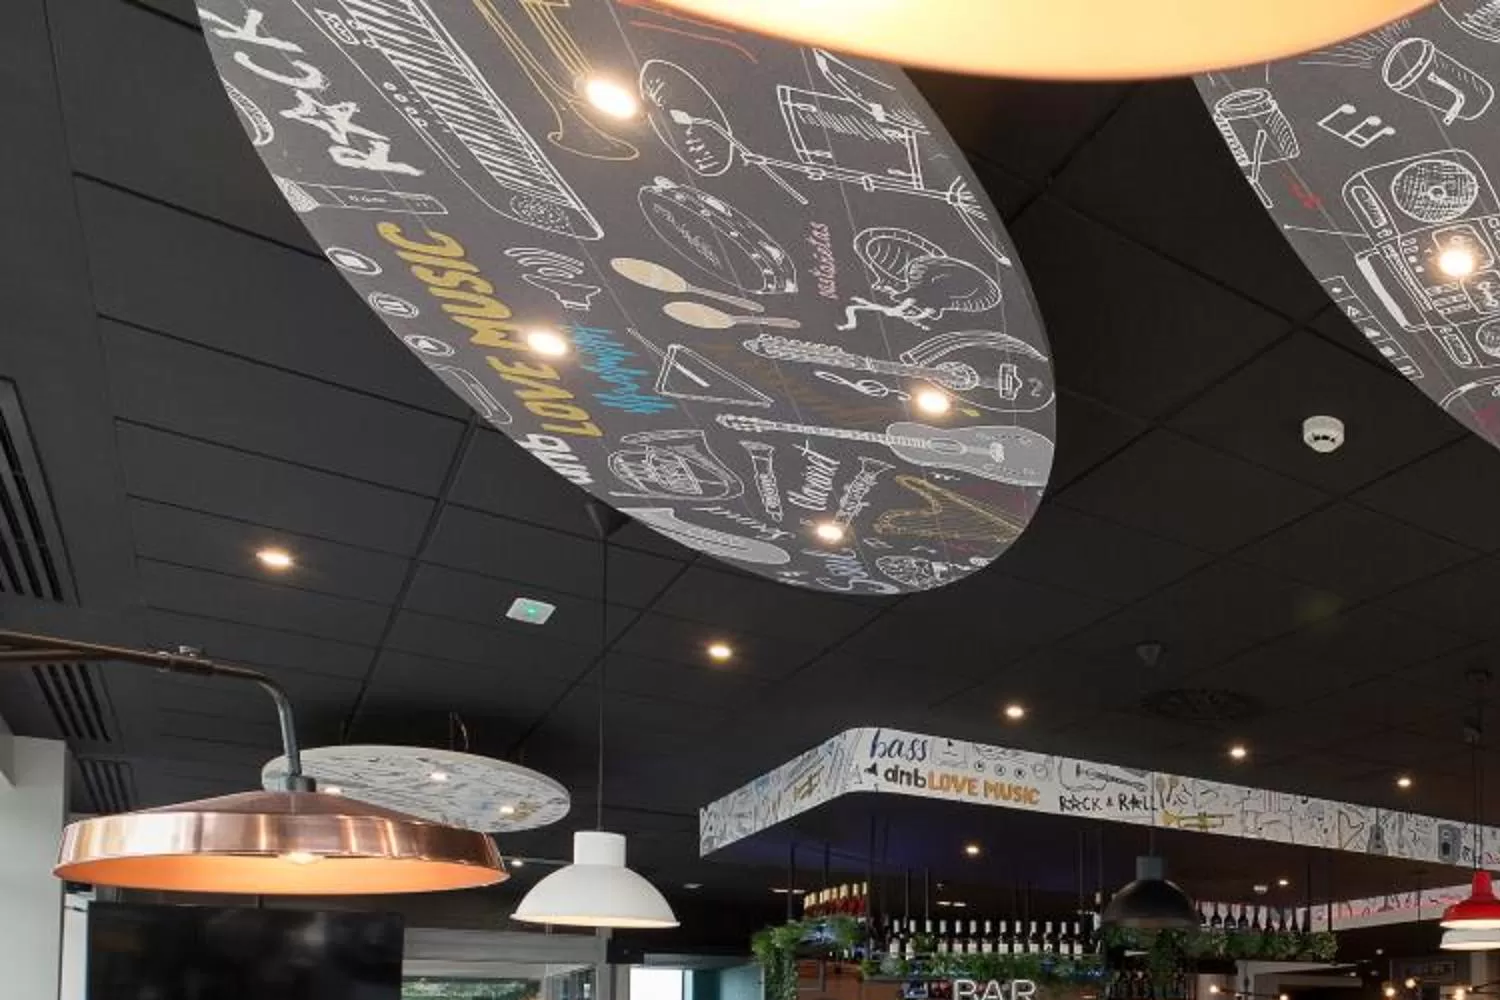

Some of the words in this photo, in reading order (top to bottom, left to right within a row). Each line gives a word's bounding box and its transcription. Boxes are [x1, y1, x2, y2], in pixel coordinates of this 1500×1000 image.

[376, 221, 532, 352] MUSIC
[486, 354, 604, 438] LOVE
[869, 728, 929, 762] bass
[884, 764, 927, 788] dnb
[927, 769, 978, 797] LOVE
[983, 779, 1041, 805] MUSIC
